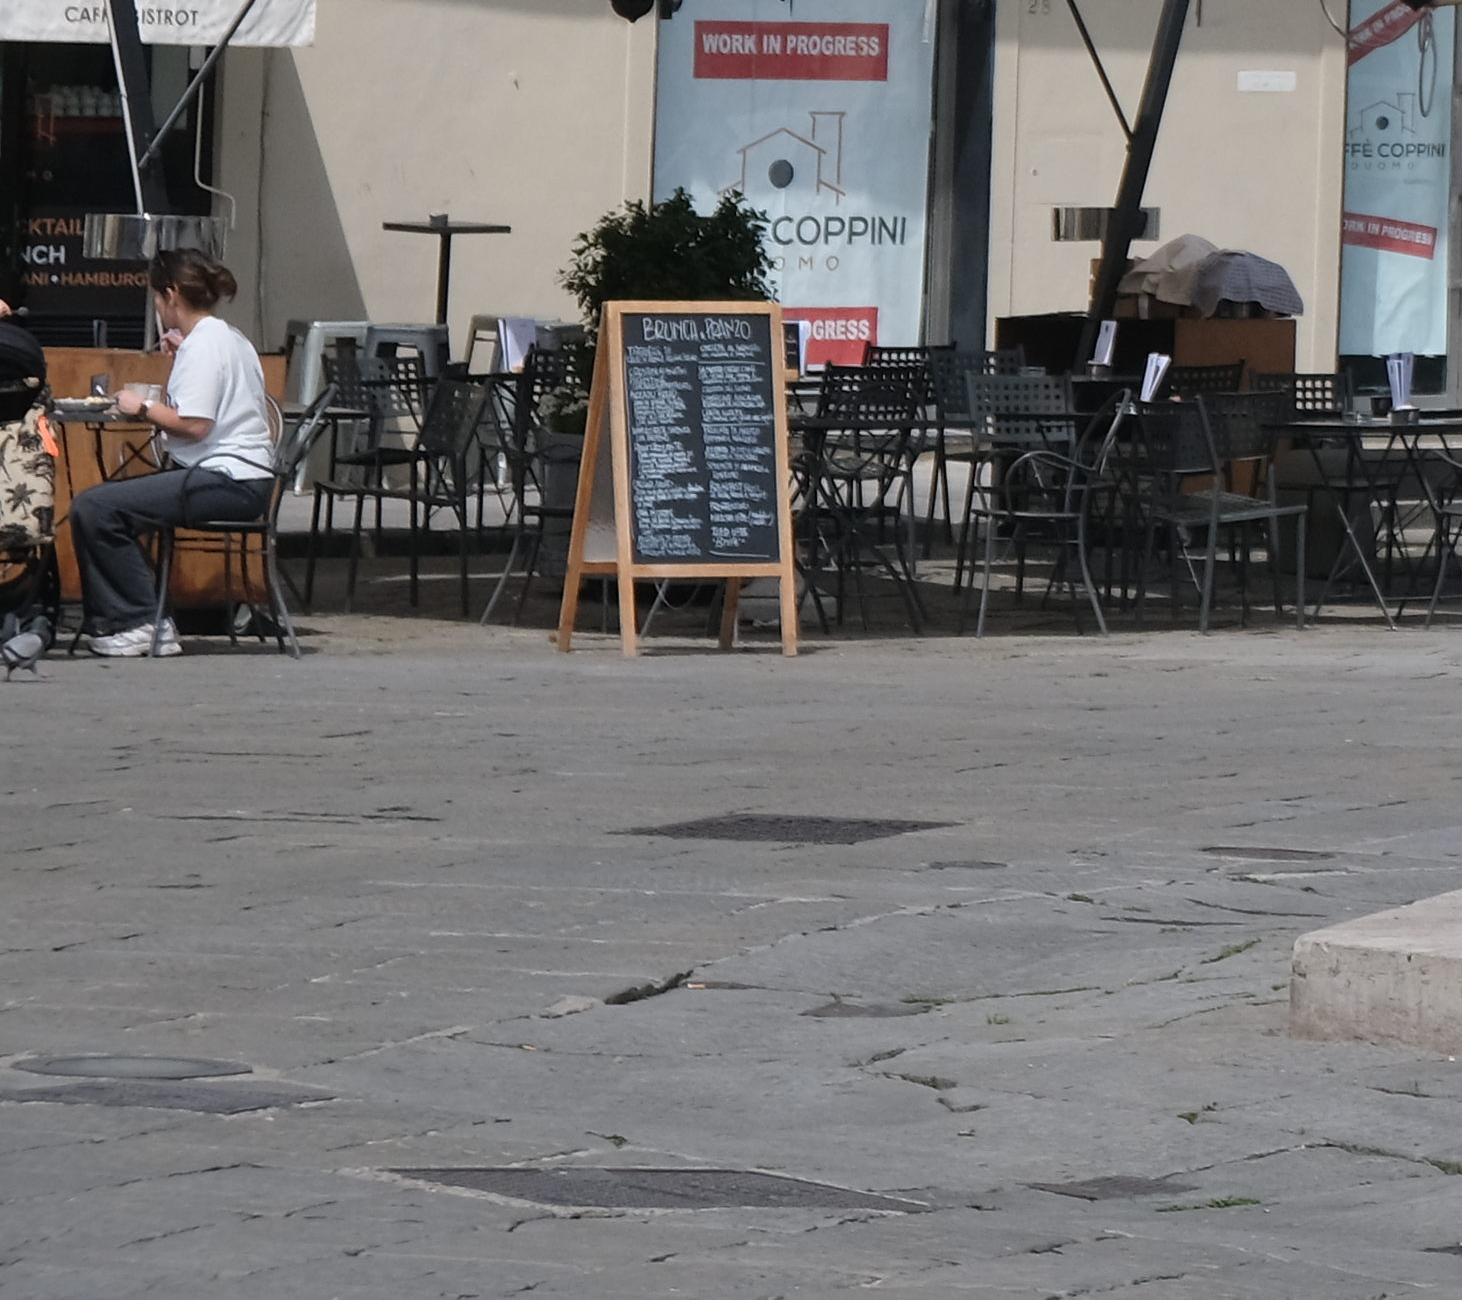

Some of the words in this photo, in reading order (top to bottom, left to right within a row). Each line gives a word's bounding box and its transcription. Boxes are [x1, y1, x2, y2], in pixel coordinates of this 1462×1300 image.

[64, 6, 107, 23] CAF
[136, 8, 199, 26] ISTROT
[702, 33, 757, 55] WORK
[763, 34, 782, 55] IN
[786, 35, 880, 57] PROGRESS
[1377, 143, 1446, 158] COPPINI
[771, 215, 907, 246] COPPINI
[60, 272, 148, 287] HAMBURG
[804, 320, 870, 341] GRESS
